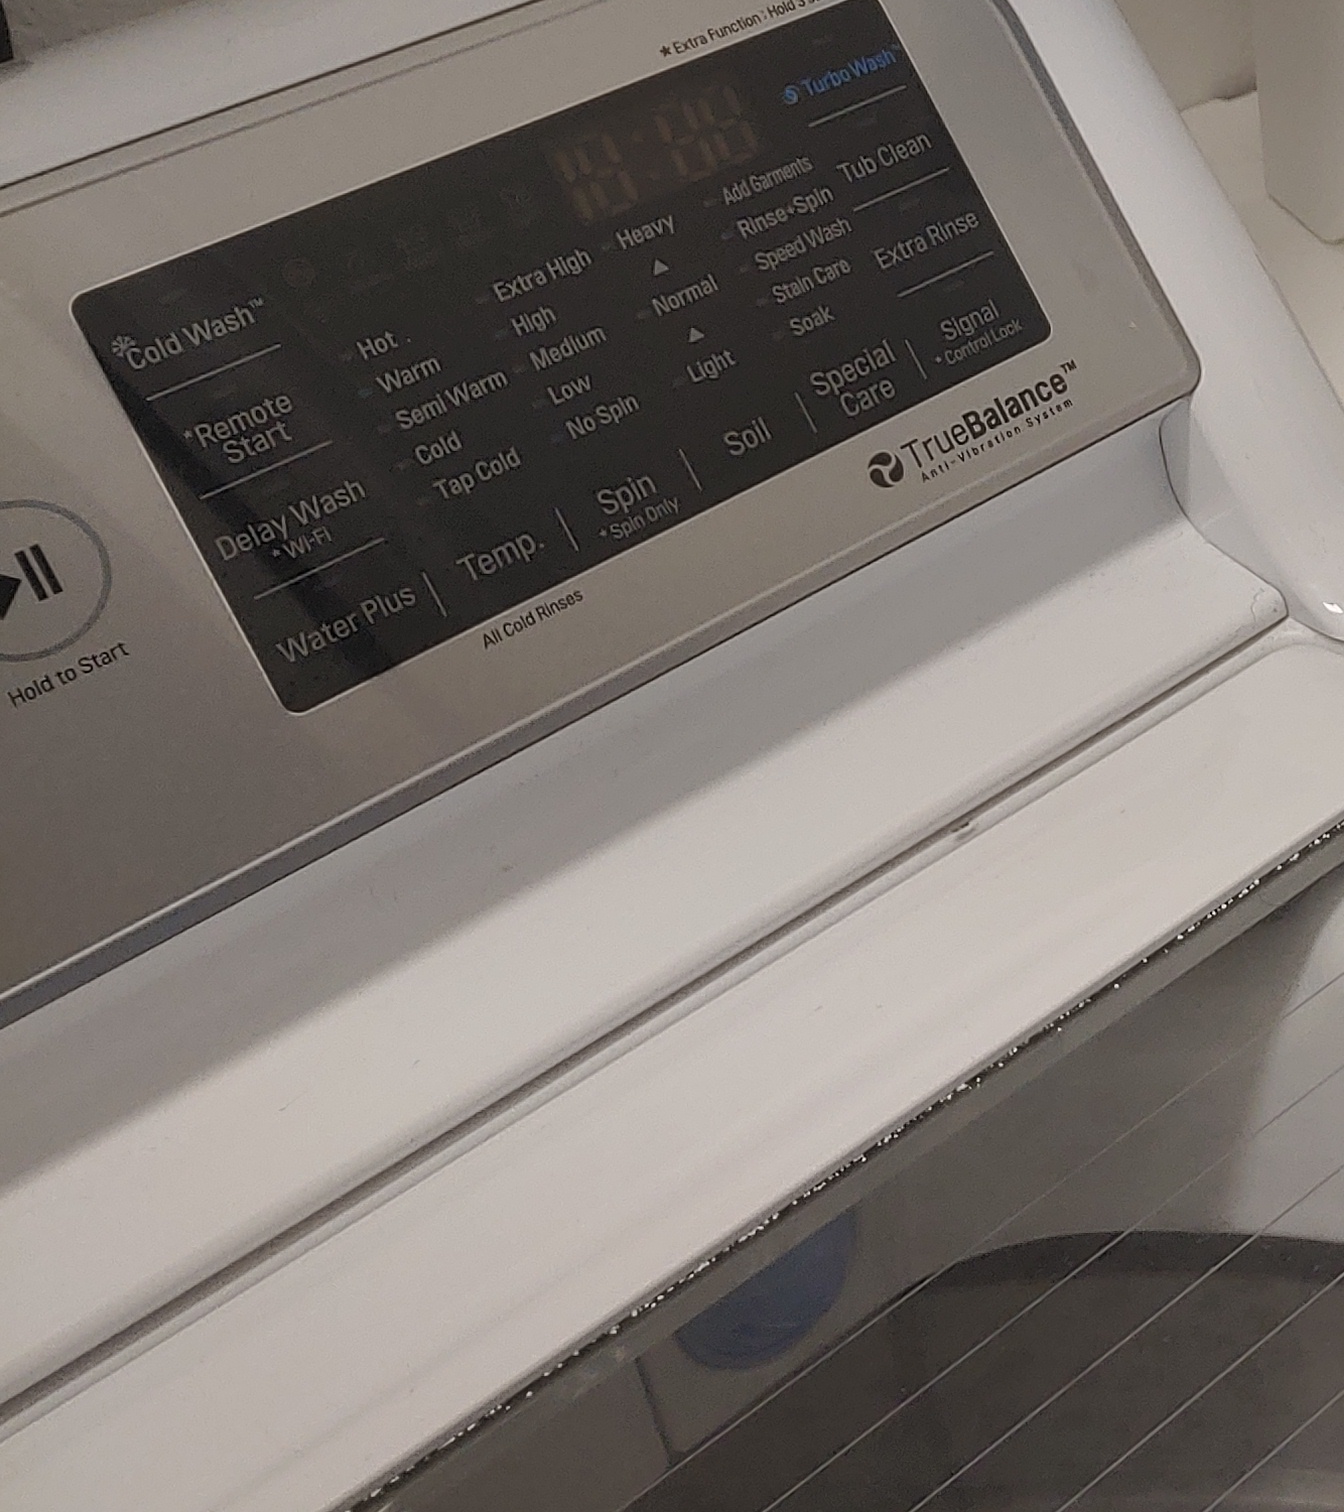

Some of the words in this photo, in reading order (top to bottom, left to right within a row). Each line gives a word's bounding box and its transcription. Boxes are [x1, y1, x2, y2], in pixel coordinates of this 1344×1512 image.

[706, 10, 761, 44] Function
[836, 149, 878, 184] Tub
[876, 131, 932, 169] Clean
[721, 177, 751, 206] Add
[749, 155, 813, 192] Garments
[615, 215, 675, 251] Heavy
[736, 186, 835, 241] Rinse+Spin
[754, 235, 807, 272] Speed
[804, 216, 852, 250] Wash
[873, 233, 928, 271] Extra
[925, 209, 980, 248] Rinse
[493, 269, 547, 303] Extra
[547, 249, 593, 281] High
[651, 274, 719, 317] Normal
[772, 270, 815, 305] Stain
[813, 256, 851, 286] Care
[510, 305, 558, 338] High
[789, 304, 835, 338] Soak
[940, 299, 1000, 341] Signal
[992, 318, 1023, 346] Lock
[125, 329, 182, 372] Cold
[356, 330, 398, 361] Hot
[529, 326, 607, 372] Medium
[686, 348, 737, 384] Light
[376, 356, 442, 394] Warm
[547, 374, 592, 406] Low
[810, 340, 897, 397] Special
[395, 394, 447, 431] Semi
[445, 370, 508, 409] Warm
[565, 411, 596, 441] No
[595, 394, 640, 427] Spin
[839, 379, 897, 418] Care
[222, 421, 293, 466] Start
[414, 430, 463, 467] Cold
[723, 417, 773, 456] Soil
[920, 427, 1024, 484] Anti-Vibration
[1025, 398, 1074, 432] System
[432, 472, 476, 501] Tap
[475, 447, 522, 484] Cold
[597, 473, 657, 517] Spin
[213, 510, 288, 562] Delay
[287, 478, 366, 529] Wash
[645, 496, 681, 522] Only
[456, 528, 545, 583] Temp.
[274, 608, 360, 664] Water
[360, 584, 417, 627] Plus
[482, 627, 504, 650] All
[502, 611, 537, 639] Cold
[537, 589, 585, 622] Rinses
[8, 674, 53, 708] Hold
[56, 665, 77, 686] to
[79, 640, 130, 677] Start
